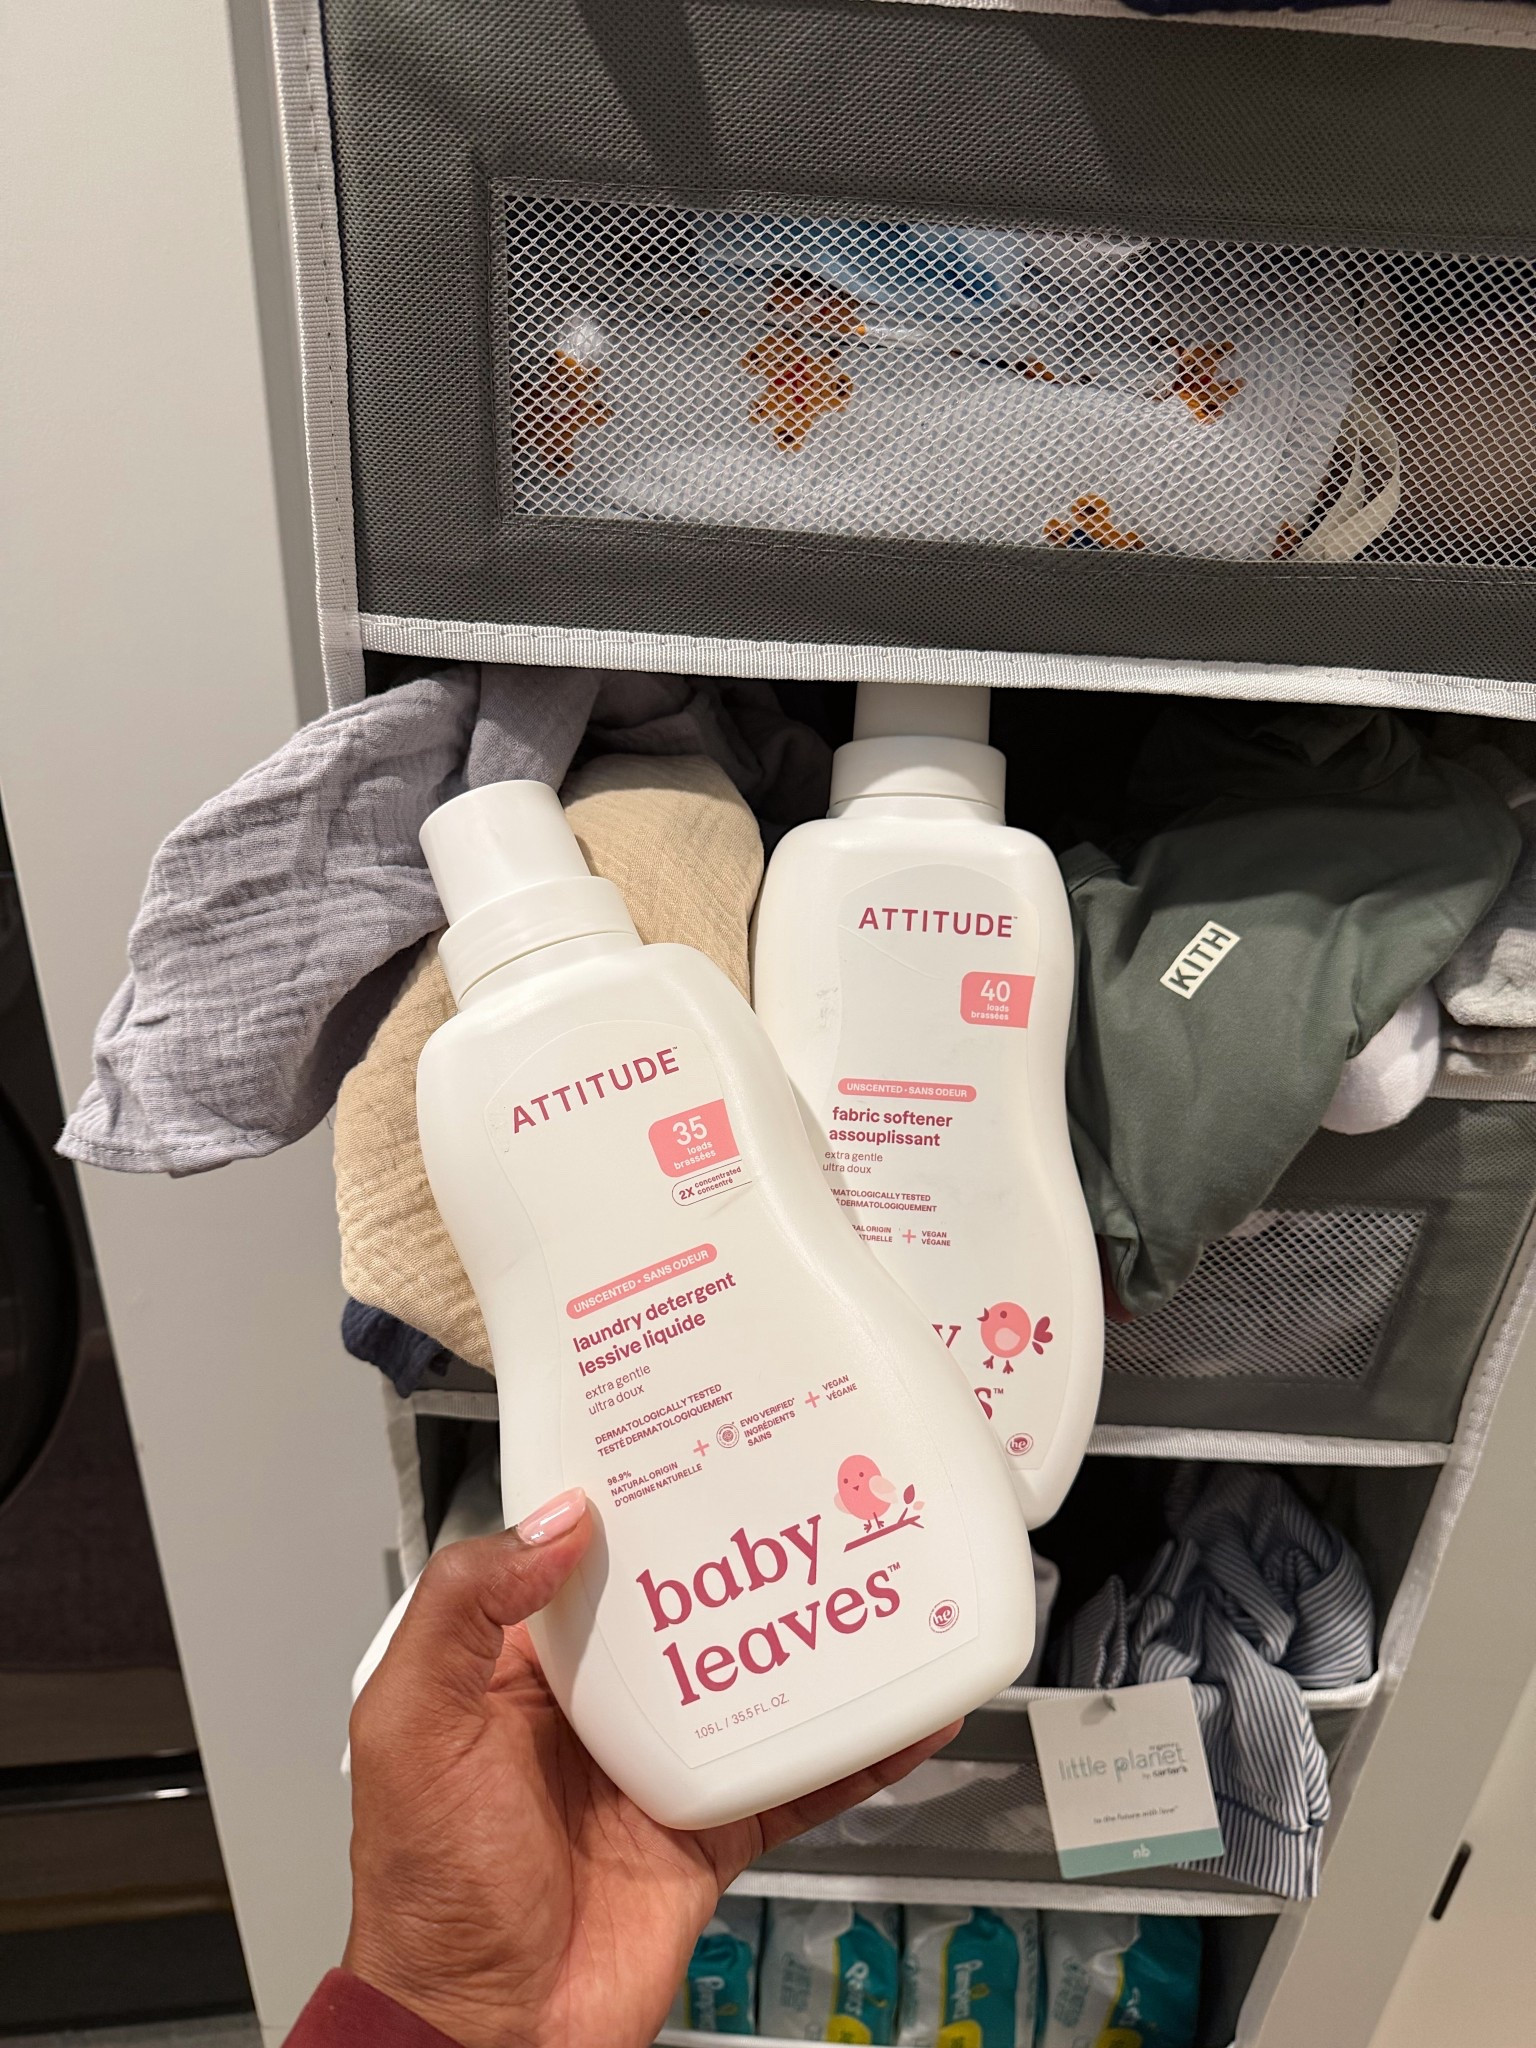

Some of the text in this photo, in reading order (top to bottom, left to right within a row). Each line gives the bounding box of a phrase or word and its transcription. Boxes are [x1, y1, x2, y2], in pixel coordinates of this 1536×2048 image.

[1167, 927, 1232, 992] KITH
[980, 979, 1011, 1002] 40
[970, 1010, 1009, 1021] brassées
[986, 1003, 1010, 1013] loads
[846, 1082, 967, 1098] UNSCENTED SANS ODEUR
[832, 1106, 953, 1128] fabric softener
[672, 1115, 708, 1146] 35
[828, 1128, 941, 1147] assouplissant
[686, 1140, 713, 1156] loads
[824, 1150, 883, 1163] extra gentle
[673, 1149, 717, 1170] brassées
[822, 1162, 872, 1174] ultra doux
[694, 1165, 742, 1189] concentrated
[696, 1176, 734, 1196] concentré
[678, 1185, 696, 1200] 2X
[900, 1192, 931, 1202] TESTED
[840, 1199, 938, 1213] DERMATOLOGIQUEMENT
[865, 1225, 892, 1234] ORIGIN
[921, 1230, 947, 1238] VEGAN
[921, 1238, 951, 1247] VÉGANE
[573, 1249, 709, 1313] UNSCENTED SANS ODEUR
[573, 1272, 737, 1353] laundry detergent
[578, 1313, 706, 1377] lessive liquide
[585, 1363, 651, 1400] extra gentle
[821, 1374, 850, 1391] VEGAN
[588, 1384, 645, 1416] ultra doux
[825, 1383, 858, 1401] VÉGANE
[594, 1398, 689, 1445] DERMATOLOGICALLY
[687, 1383, 722, 1404] TESTED
[597, 1438, 627, 1457] TESTÉ
[626, 1391, 734, 1446] DERMATOLOGIQUEMENT
[739, 1413, 760, 1428] EWG
[743, 1410, 796, 1438] INGRÉDIENTS
[747, 1431, 773, 1447] SAINS
[607, 1470, 632, 1486] 98.9%
[610, 1461, 679, 1497] NATURAL ORIGIN
[614, 1463, 703, 1508] D'ORIGINE NATURELLE
[635, 1513, 822, 1633] baby
[715, 1720, 724, 1732] L
[731, 1708, 755, 1725] 35.5
[1058, 1746, 1188, 1783] little planet
[1132, 1843, 1151, 1859] nb
